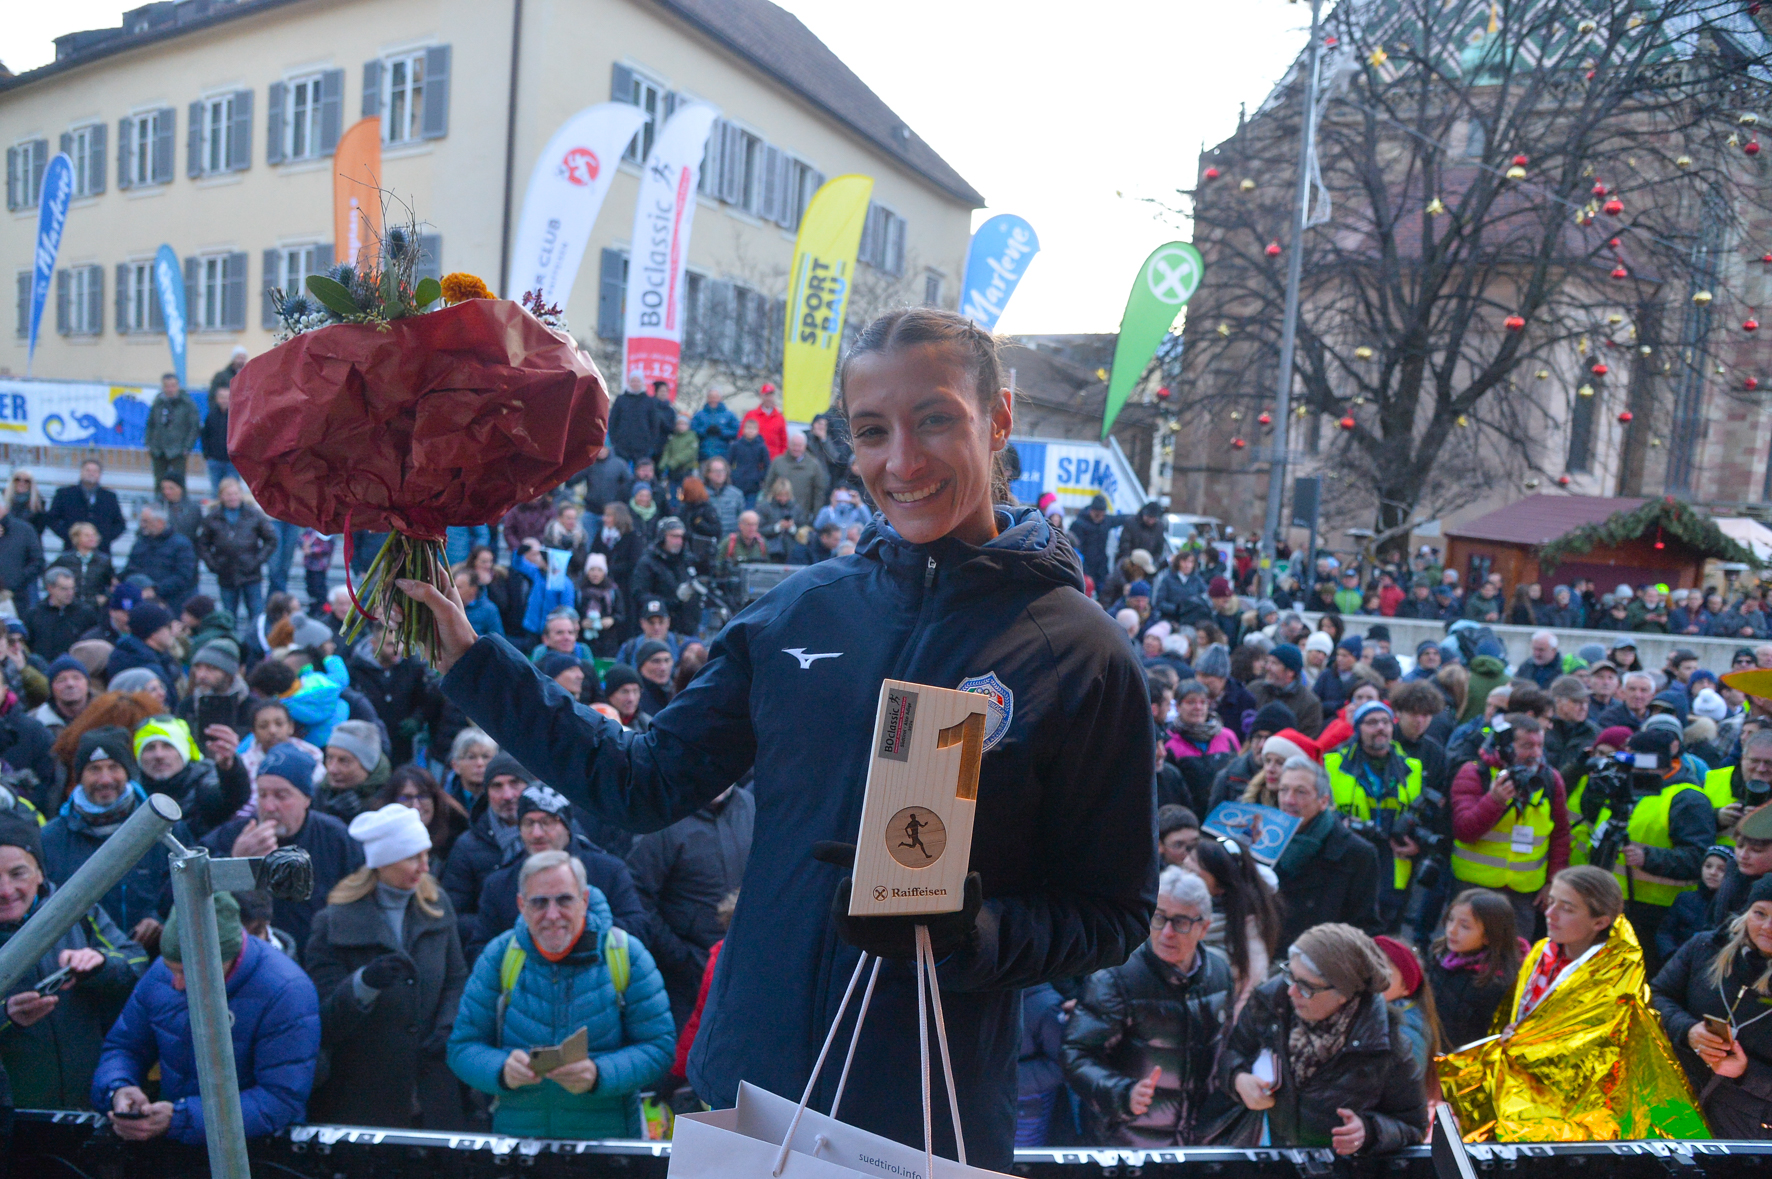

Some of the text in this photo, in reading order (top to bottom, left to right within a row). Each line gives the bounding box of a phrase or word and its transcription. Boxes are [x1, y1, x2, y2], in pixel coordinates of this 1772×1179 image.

[536, 216, 562, 268] CLUB
[640, 199, 674, 328] BOclassic
[801, 257, 830, 346] SPORT
[963, 226, 1031, 322] Marlene
[821, 276, 848, 334] BAU
[884, 706, 900, 754] BOclassic
[937, 712, 986, 800] 1
[891, 886, 948, 898] Raiffeisen
[859, 1153, 922, 1179] suedtirol.info
